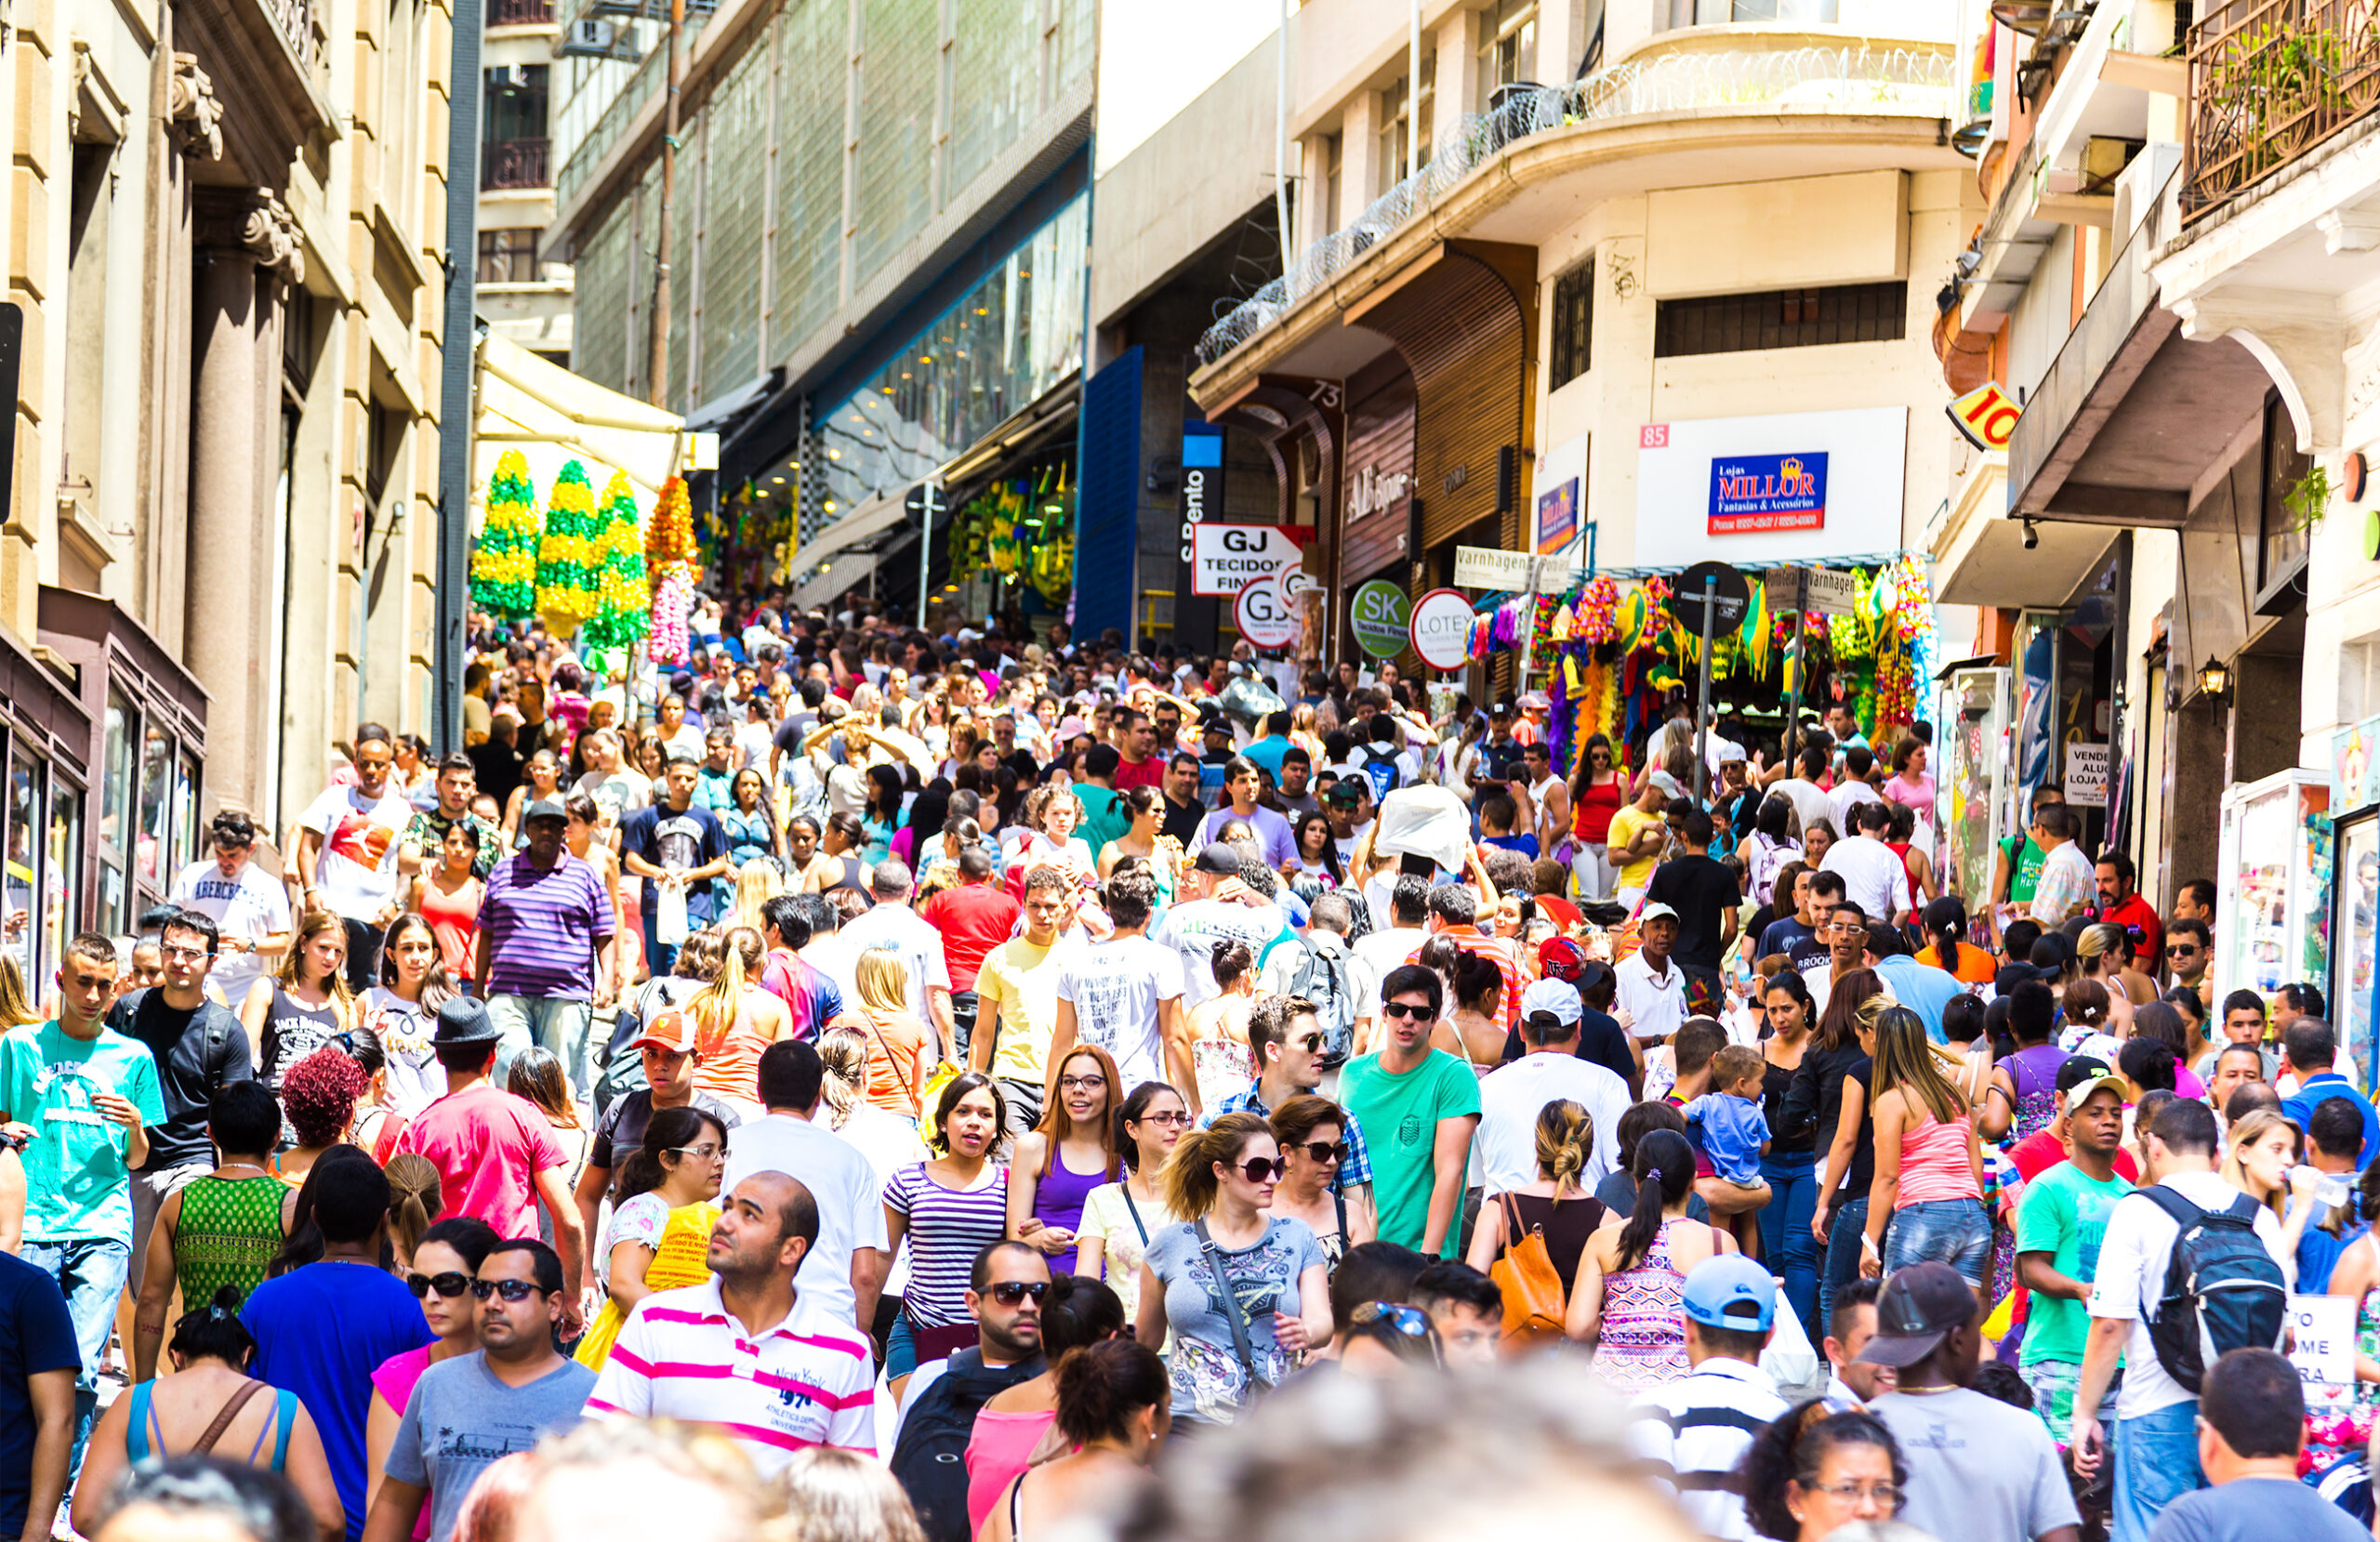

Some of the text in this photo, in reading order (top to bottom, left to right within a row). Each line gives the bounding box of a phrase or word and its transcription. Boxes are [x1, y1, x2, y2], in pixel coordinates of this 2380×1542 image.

[1309, 379, 1341, 407] 73
[1644, 427, 1665, 446] 85
[1719, 465, 1745, 477] Lojas
[1718, 472, 1816, 501] MILLOR
[1718, 496, 1815, 513] Fantasias & Acessórios
[1223, 530, 1268, 552] GJ
[1457, 548, 1527, 573] Varnhagen
[1218, 577, 1247, 589] FIN
[1766, 567, 1798, 587] Porto Geral
[1808, 570, 1856, 595] Varnhagen
[1364, 589, 1402, 624] SK
[1356, 618, 1385, 636] Tecidos
[2073, 750, 2109, 762] VENDE
[2069, 774, 2098, 785] LOJA
[1546, 958, 1570, 979] NY
[1797, 956, 1832, 969] BROOK
[2297, 1367, 2326, 1383] RA
[765, 1404, 800, 1422] ATHLETICS
